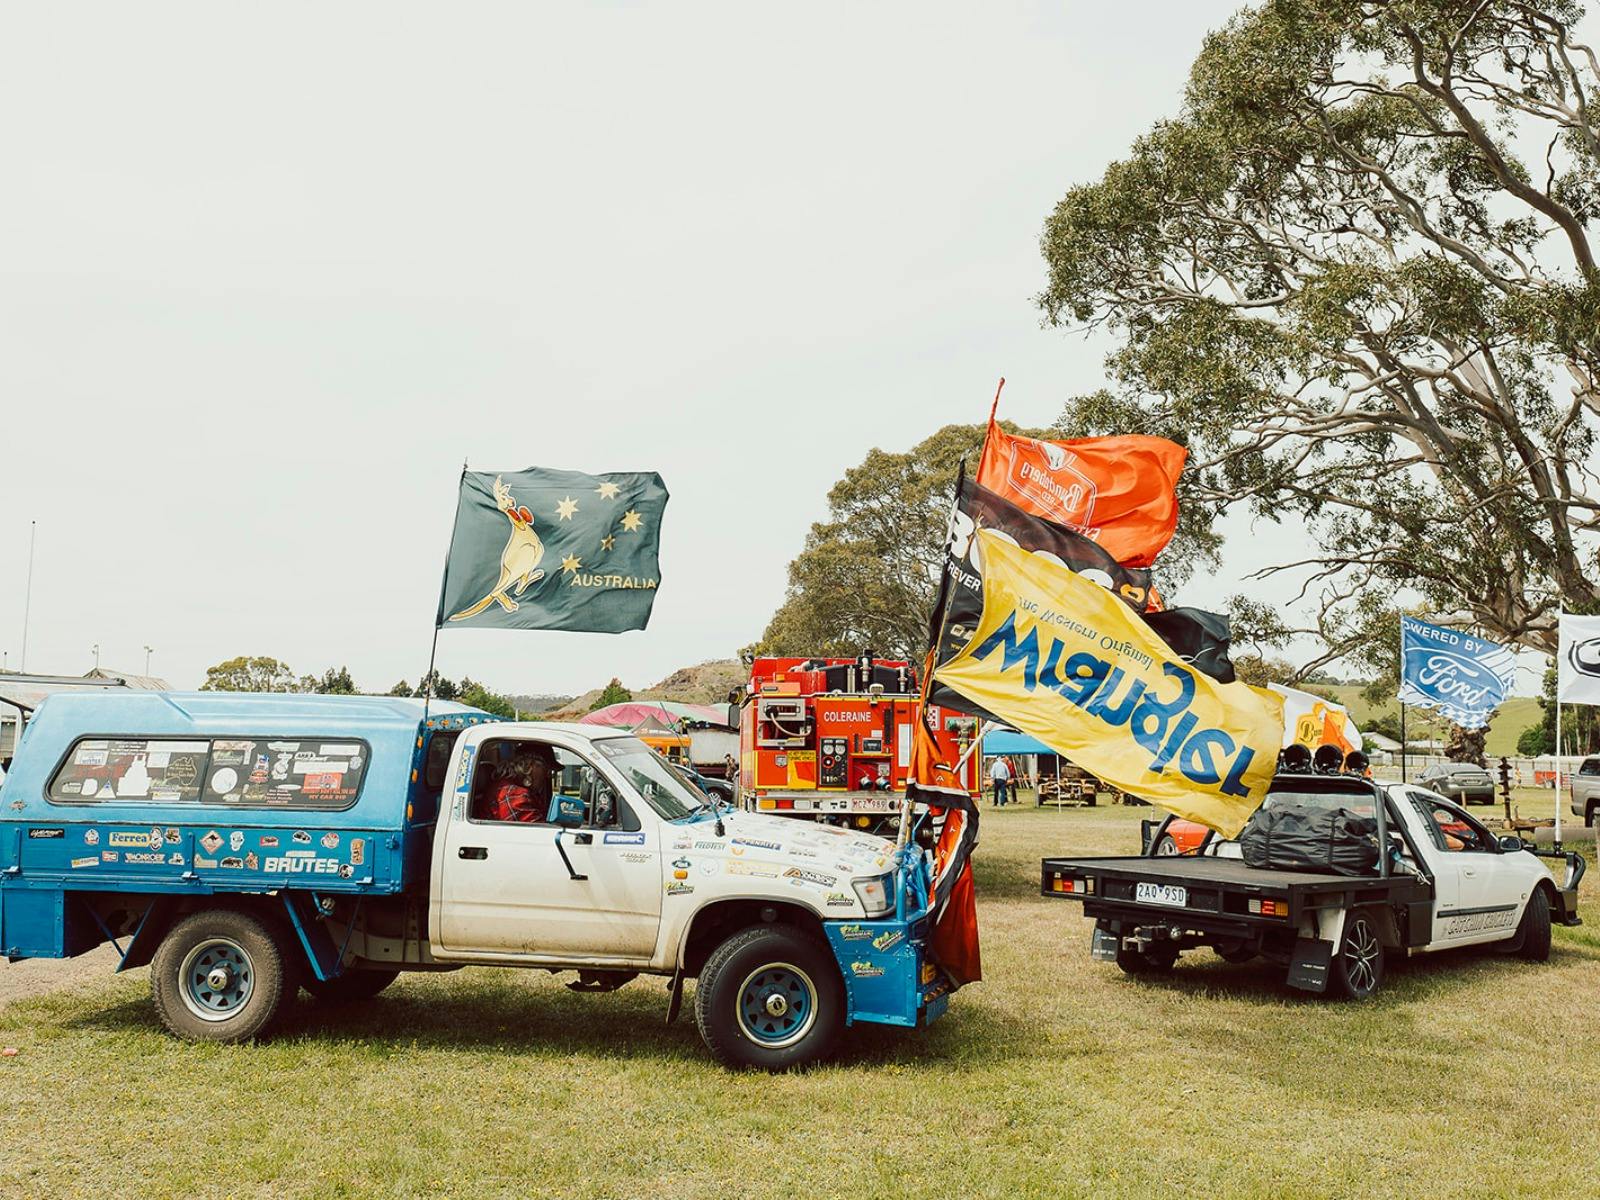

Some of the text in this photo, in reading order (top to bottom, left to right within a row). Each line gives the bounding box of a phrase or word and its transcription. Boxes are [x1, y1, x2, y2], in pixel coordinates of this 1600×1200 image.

[570, 574, 658, 590] AUSTRALIA
[1401, 620, 1483, 654] OWERED BY
[1419, 655, 1491, 708] Ford
[823, 711, 872, 722] COLERAINE
[112, 833, 147, 843] Ferrea
[263, 857, 339, 873] BRUTES
